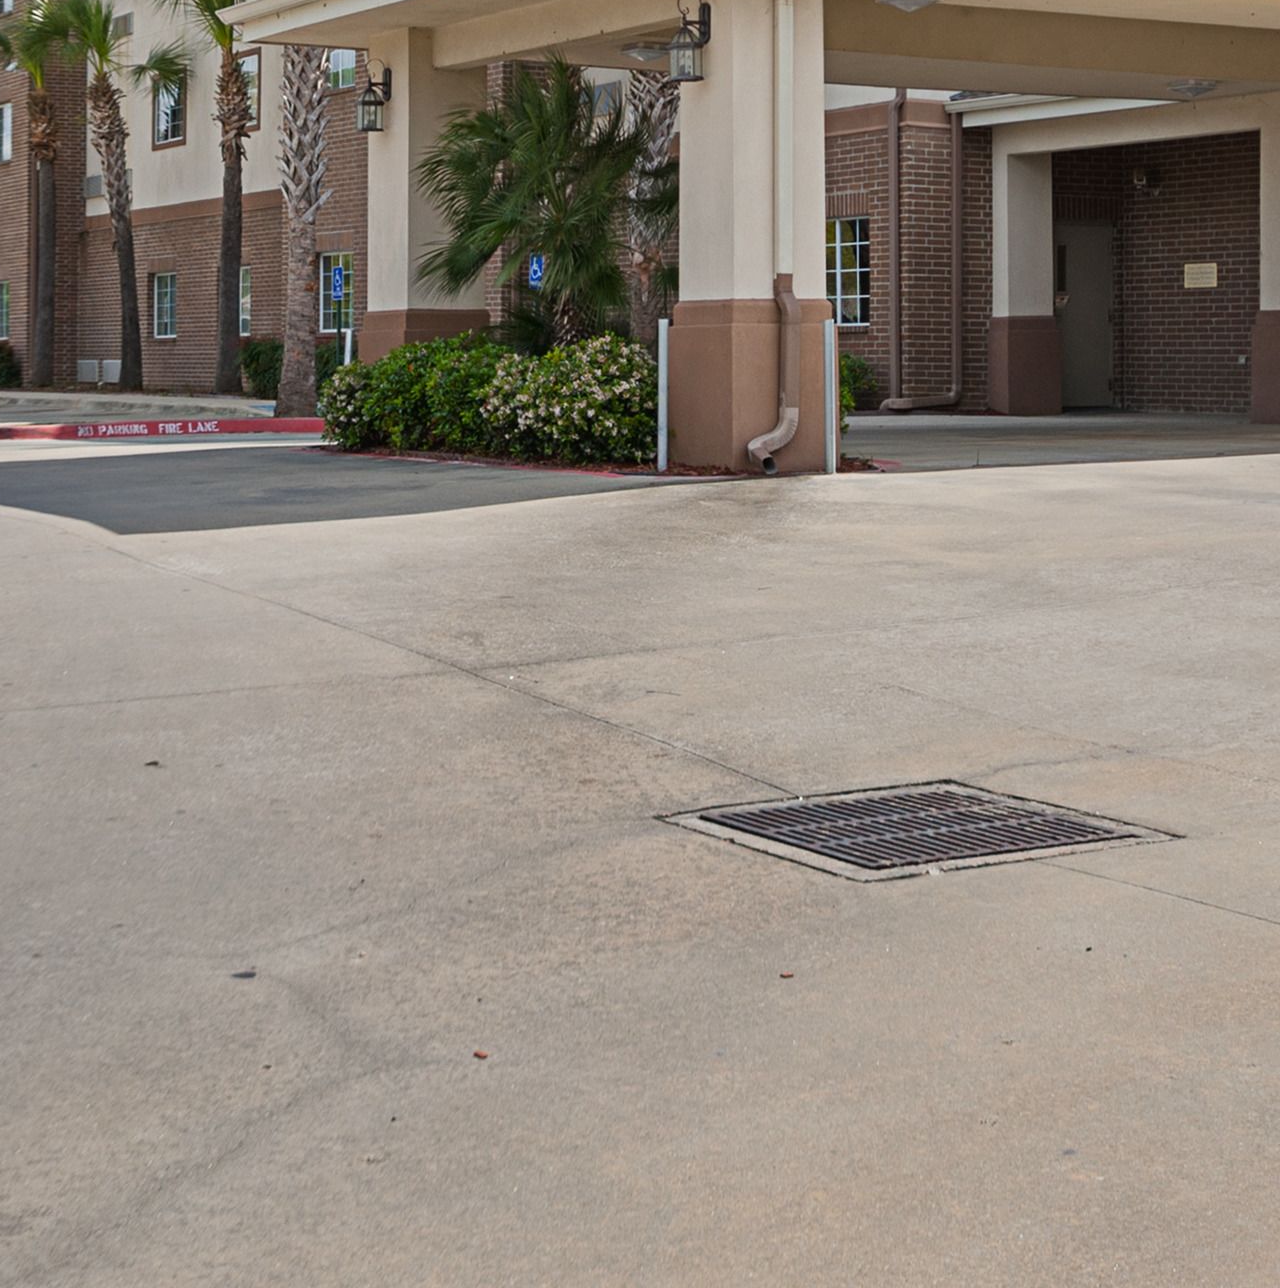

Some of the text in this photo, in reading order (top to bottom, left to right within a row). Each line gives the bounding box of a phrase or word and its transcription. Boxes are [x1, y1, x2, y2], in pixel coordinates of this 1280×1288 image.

[77, 420, 219, 437] NO PARKING FIRE LANE
